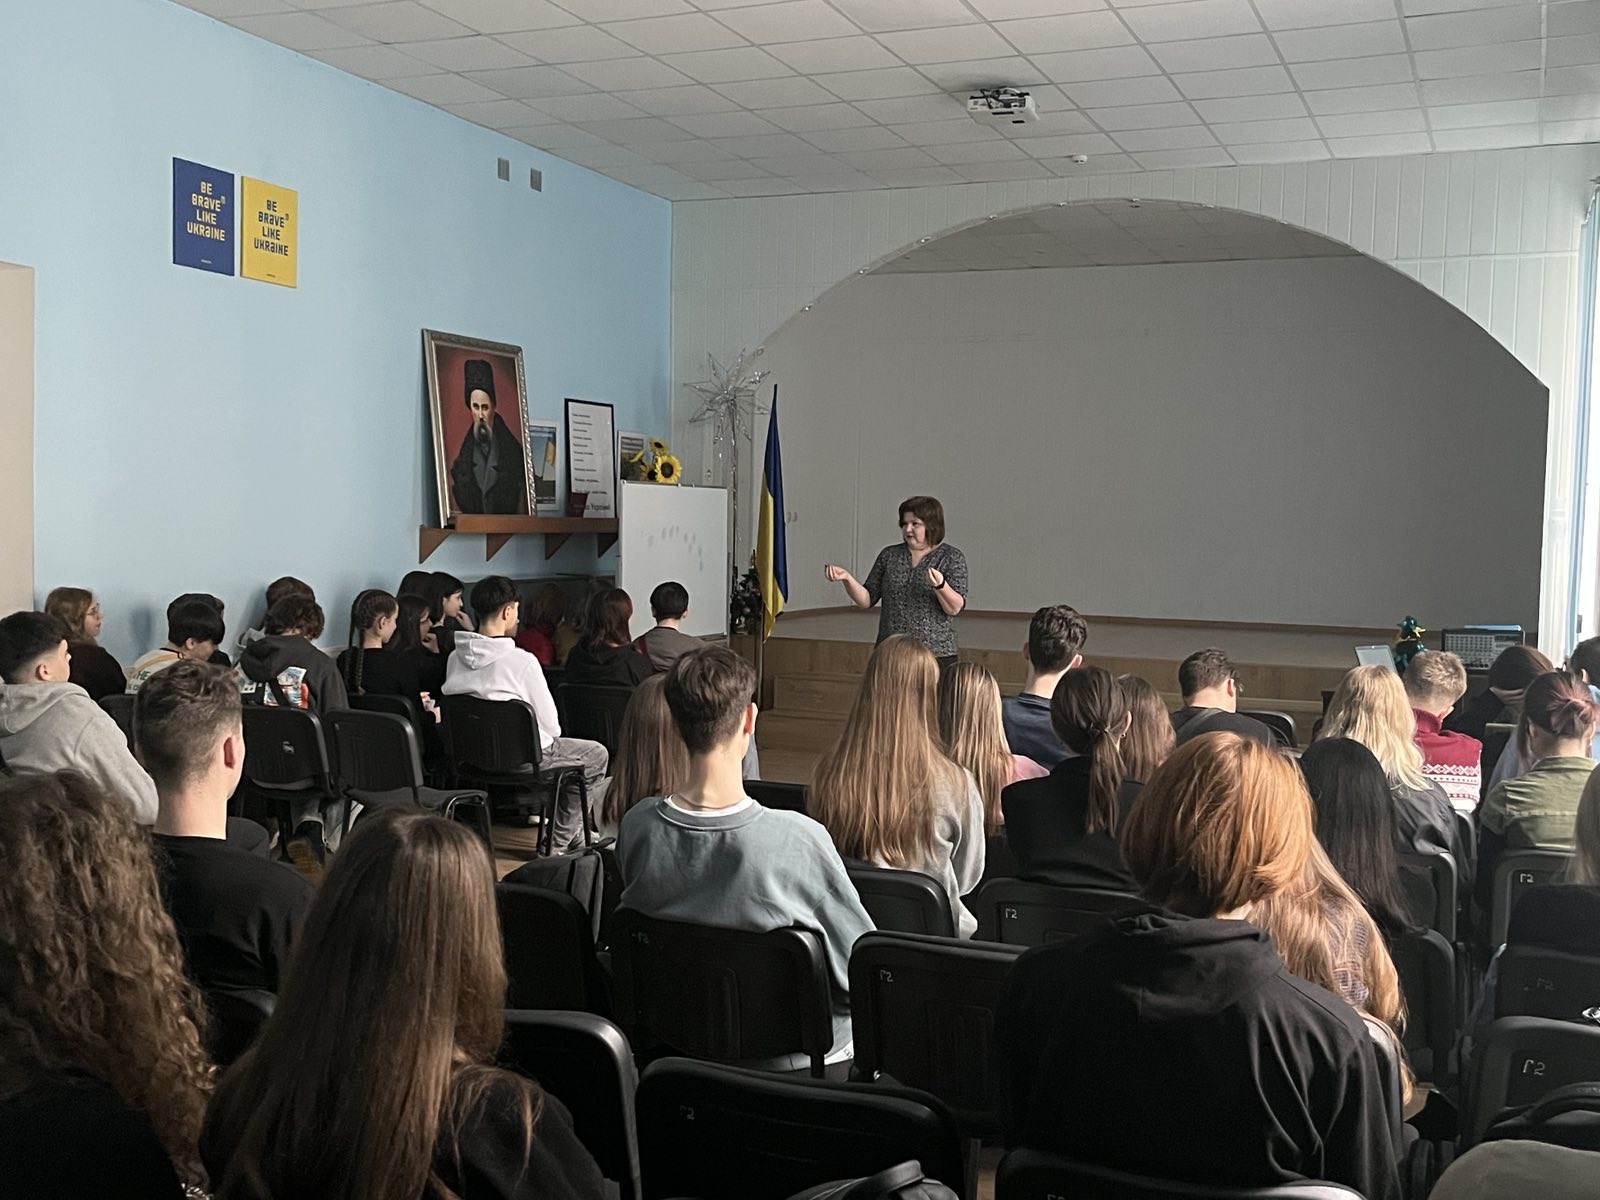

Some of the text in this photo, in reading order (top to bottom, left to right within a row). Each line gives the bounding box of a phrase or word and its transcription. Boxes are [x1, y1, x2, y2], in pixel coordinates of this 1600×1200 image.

[200, 181, 213, 194] BE
[266, 199, 277, 212] BE
[196, 211, 217, 225] LIKE
[262, 227, 281, 240] LIKE
